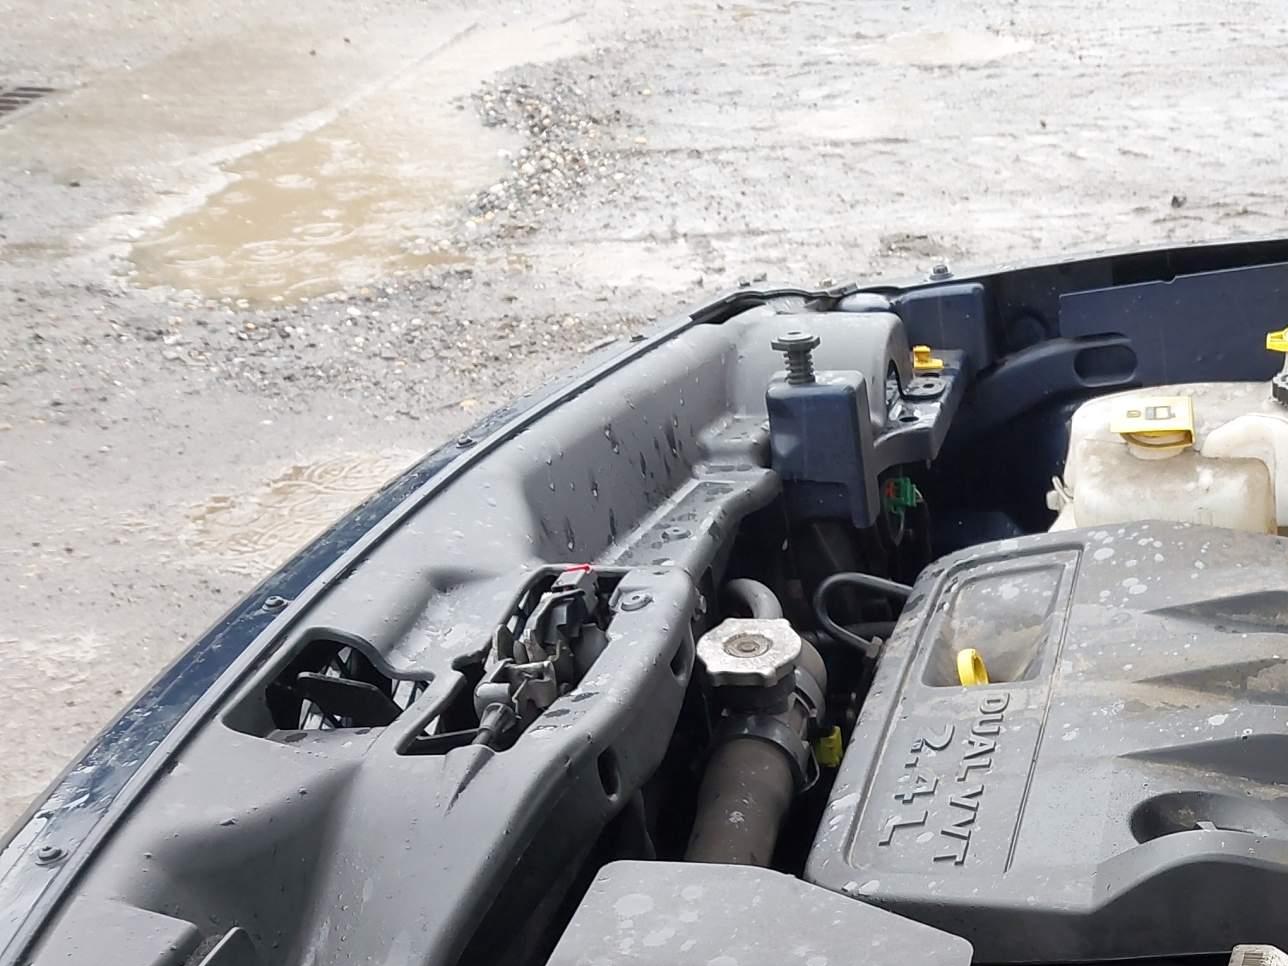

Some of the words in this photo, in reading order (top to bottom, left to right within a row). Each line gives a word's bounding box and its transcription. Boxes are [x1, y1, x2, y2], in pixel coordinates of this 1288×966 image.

[957, 692, 1010, 782] DUAL
[878, 722, 956, 847] 2.4L
[933, 784, 984, 866] VVT
